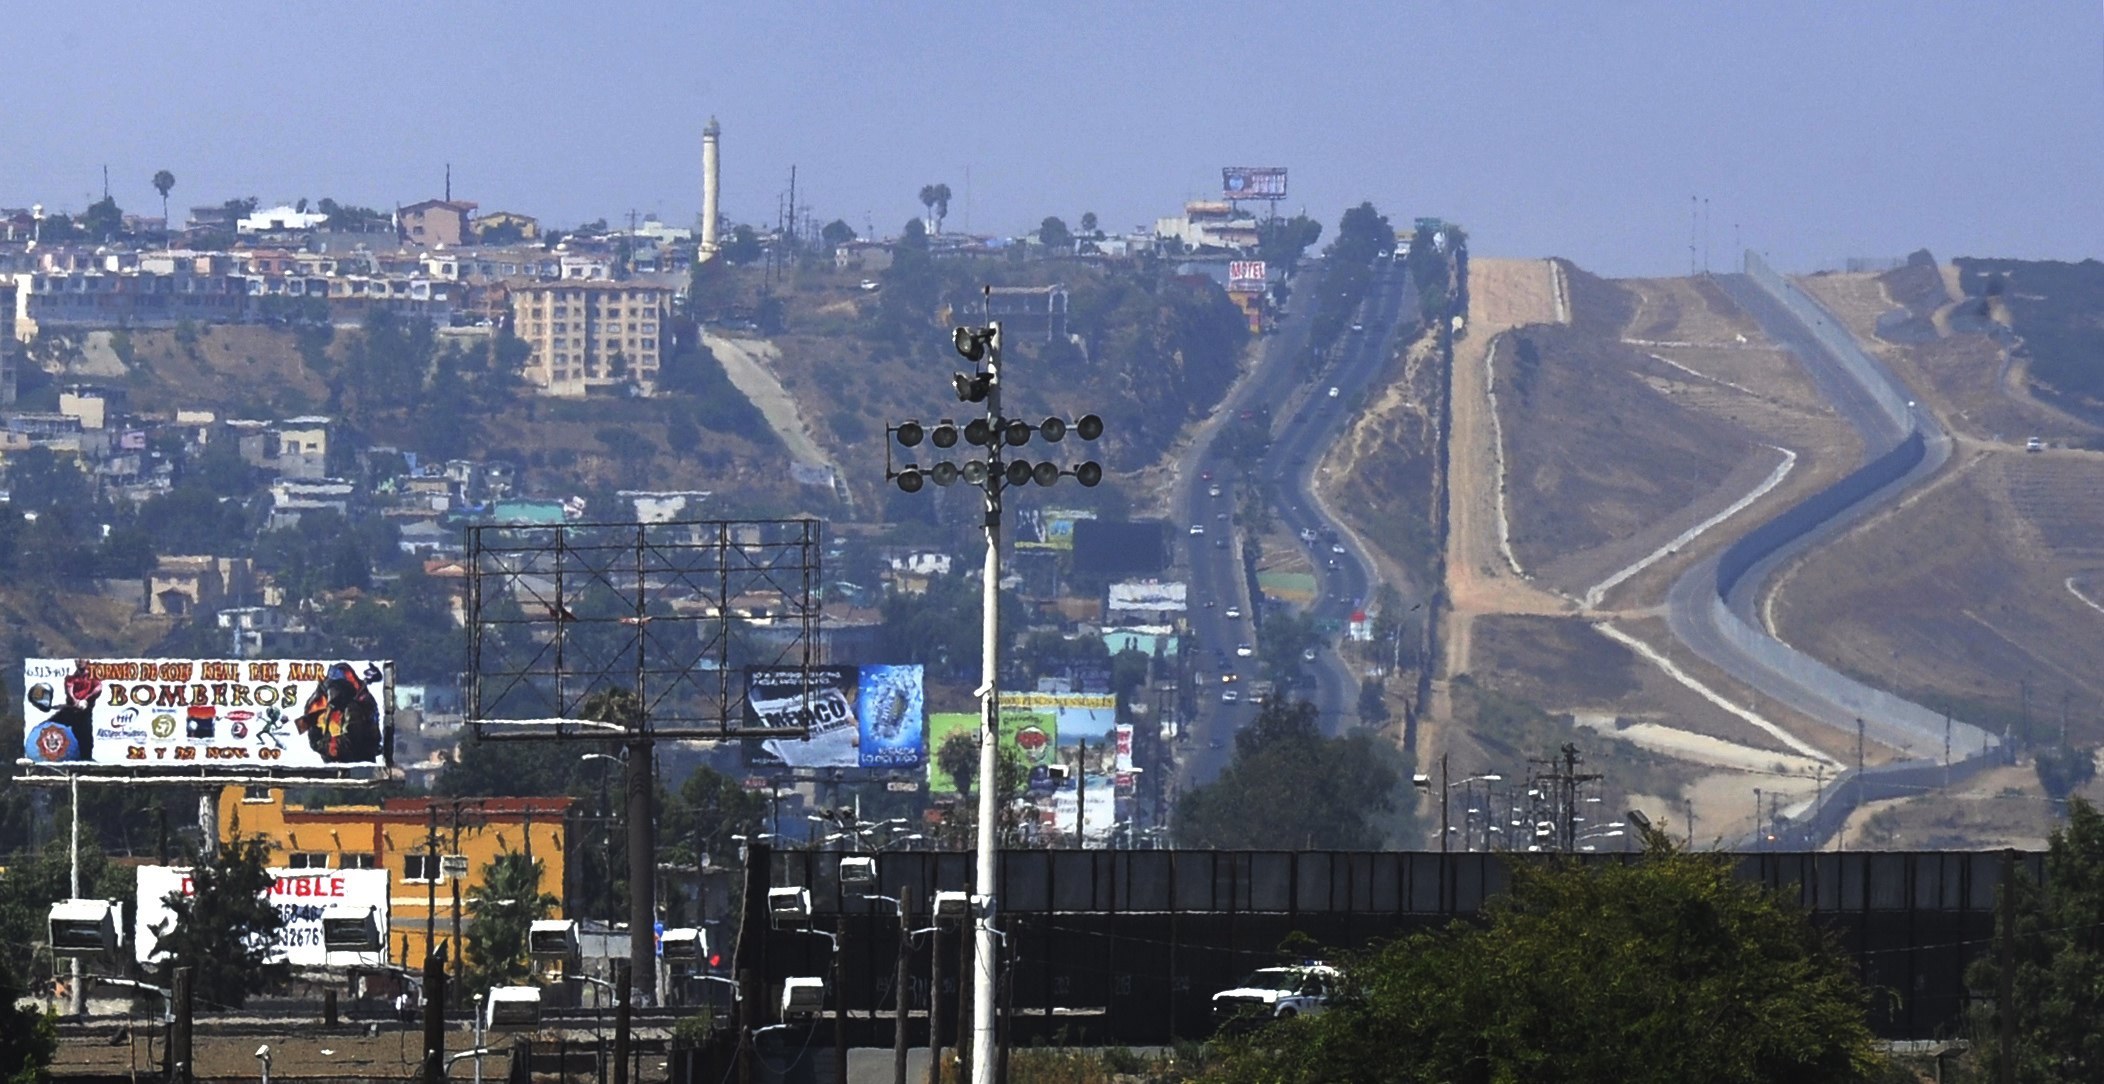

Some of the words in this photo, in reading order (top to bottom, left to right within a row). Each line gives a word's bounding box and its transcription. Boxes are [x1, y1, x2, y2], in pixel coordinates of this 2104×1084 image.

[1231, 262, 1264, 279] MOTEL
[140, 662, 158, 681] DE
[159, 662, 193, 682] GOLF
[200, 662, 239, 682] REAL
[249, 662, 280, 682] DEL
[287, 662, 327, 681] MAR
[108, 683, 298, 707] BOMBEROS
[258, 747, 281, 760] 09
[182, 877, 345, 897] DNIBLE
